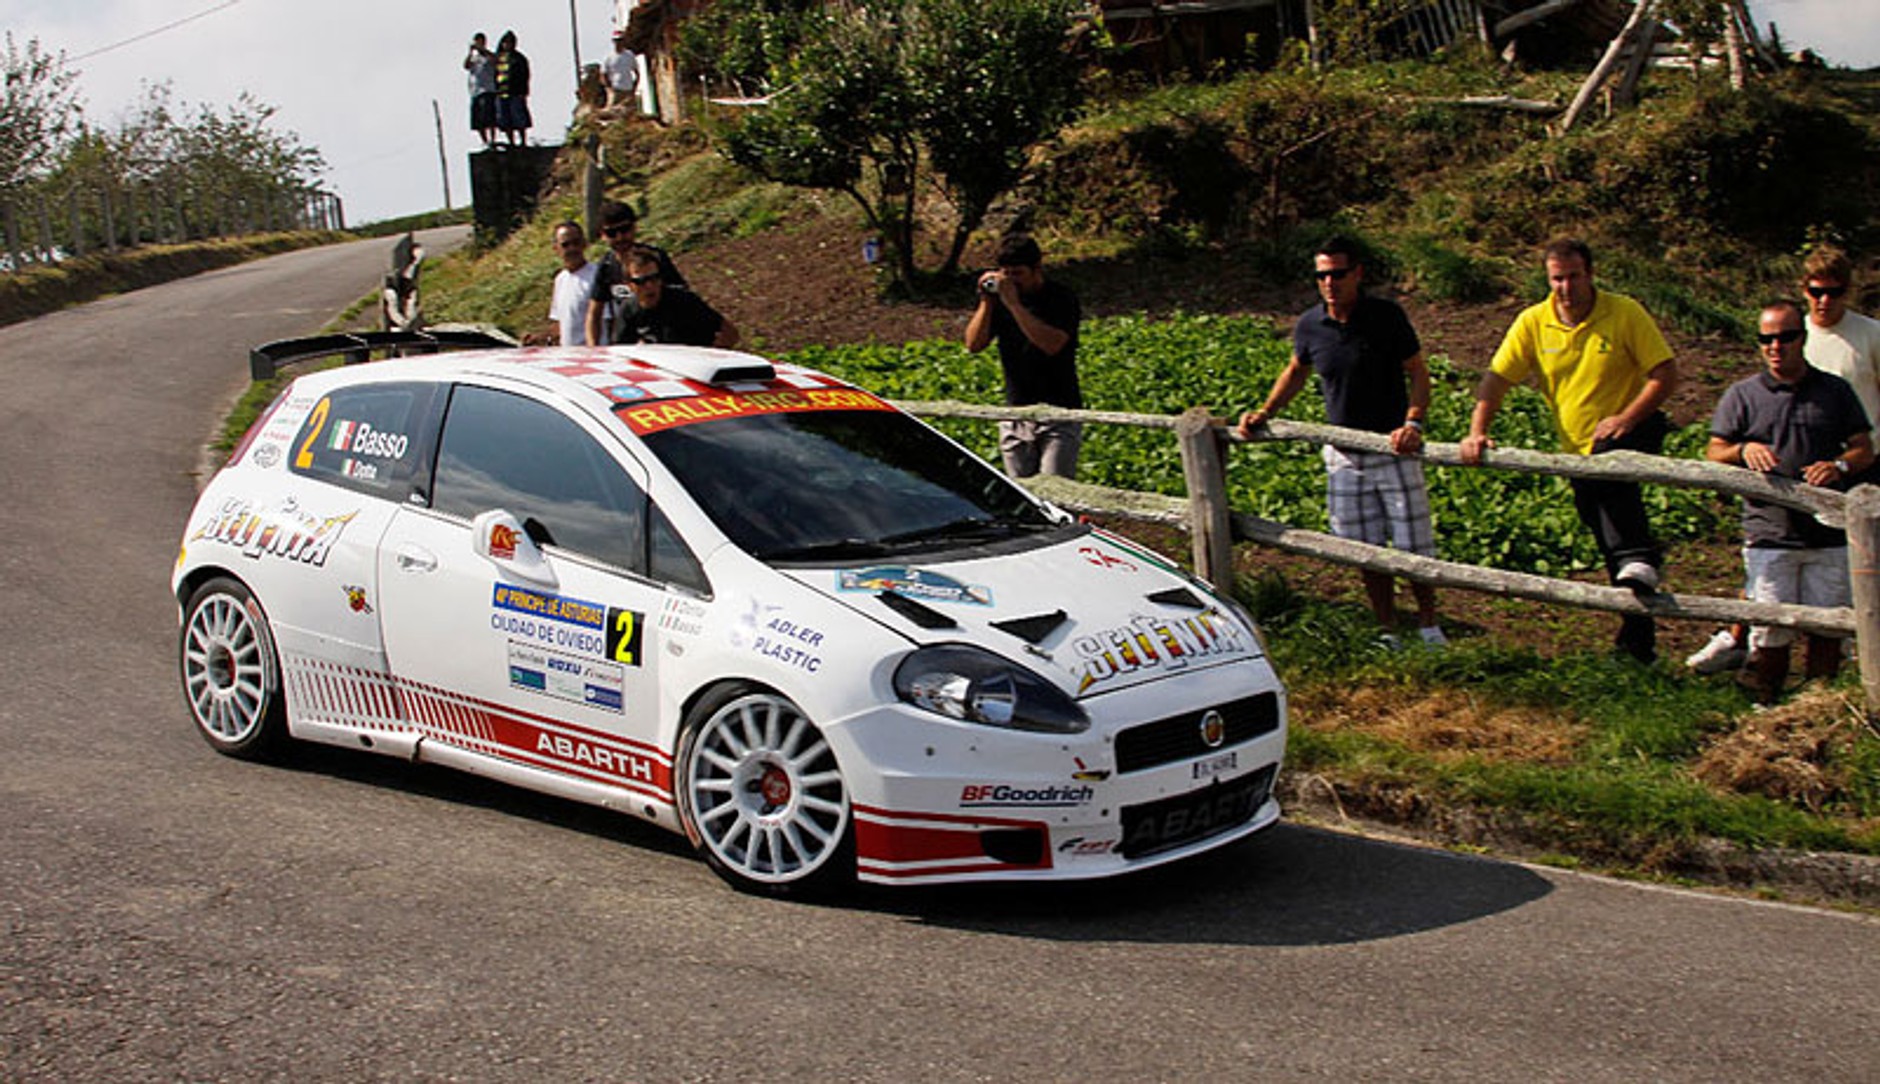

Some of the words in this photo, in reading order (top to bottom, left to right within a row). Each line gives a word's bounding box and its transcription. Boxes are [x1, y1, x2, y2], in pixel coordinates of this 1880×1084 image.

[629, 391, 883, 428] RALLY-IRC.COM
[294, 397, 330, 469] 2
[352, 422, 408, 459] Basso
[491, 614, 536, 637] CIUDAD
[538, 625, 553, 644] DE
[557, 629, 604, 655] OVIEDO
[615, 610, 634, 664] 2
[766, 618, 824, 647] ADLER
[752, 637, 823, 674] PLASTIC
[536, 732, 652, 780] ABARTH
[960, 784, 1094, 801] BFGoodrich
